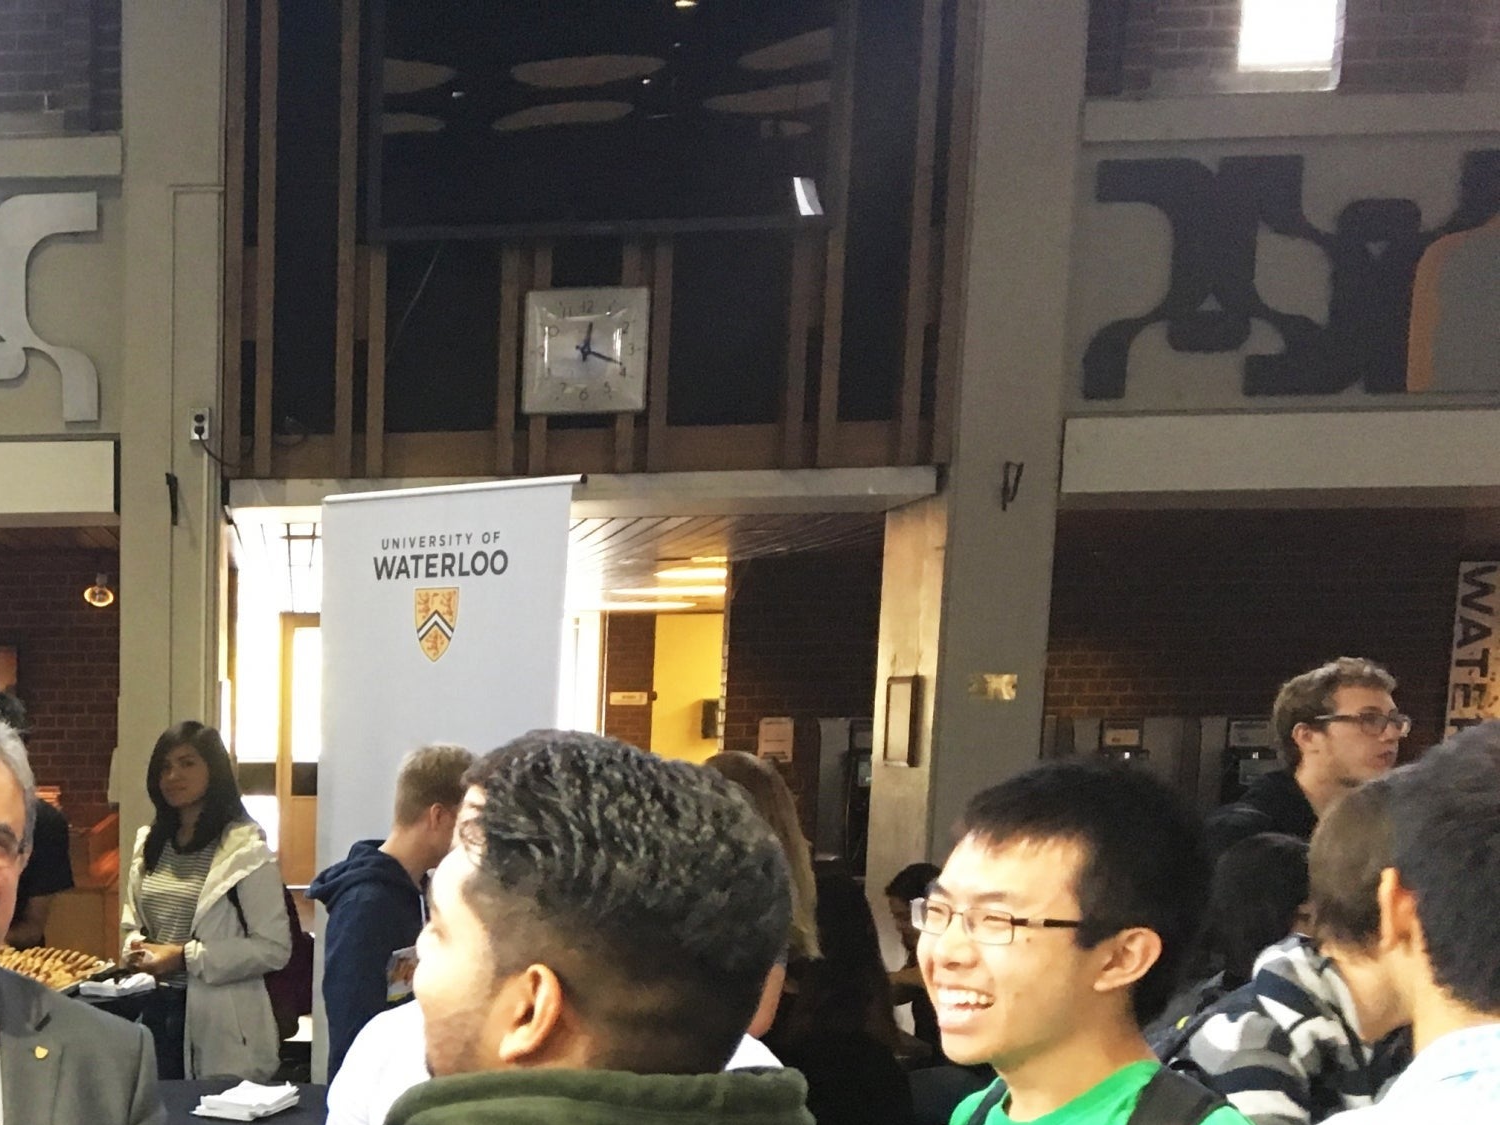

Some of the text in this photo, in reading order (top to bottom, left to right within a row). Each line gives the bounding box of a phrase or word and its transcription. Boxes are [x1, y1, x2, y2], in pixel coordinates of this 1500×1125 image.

[381, 531, 501, 551] UNIVERSITY OF
[373, 549, 509, 581] WATERLOO
